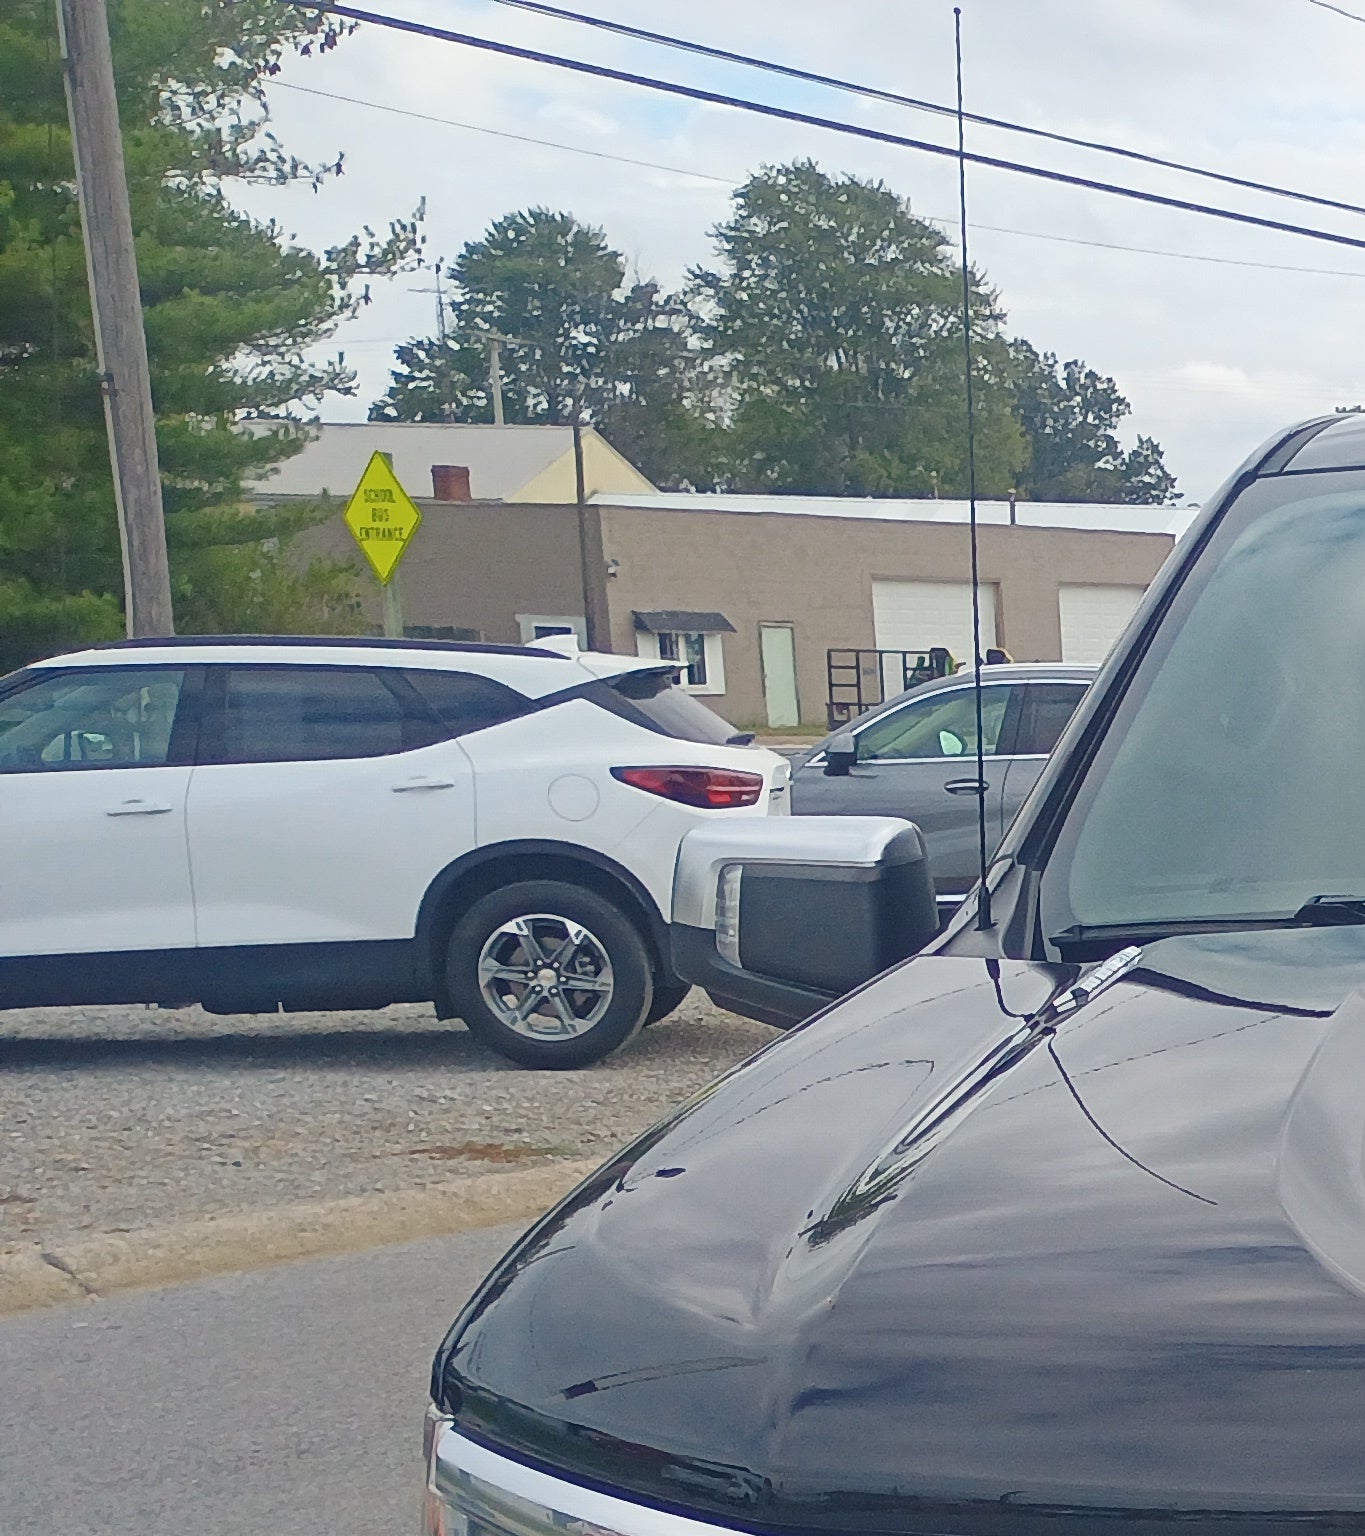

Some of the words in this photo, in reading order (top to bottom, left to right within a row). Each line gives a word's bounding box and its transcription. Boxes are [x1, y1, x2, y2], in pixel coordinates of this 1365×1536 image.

[363, 488, 396, 503] SCHOOL
[371, 507, 390, 522] BUS
[359, 526, 404, 541] ENTRANCE
